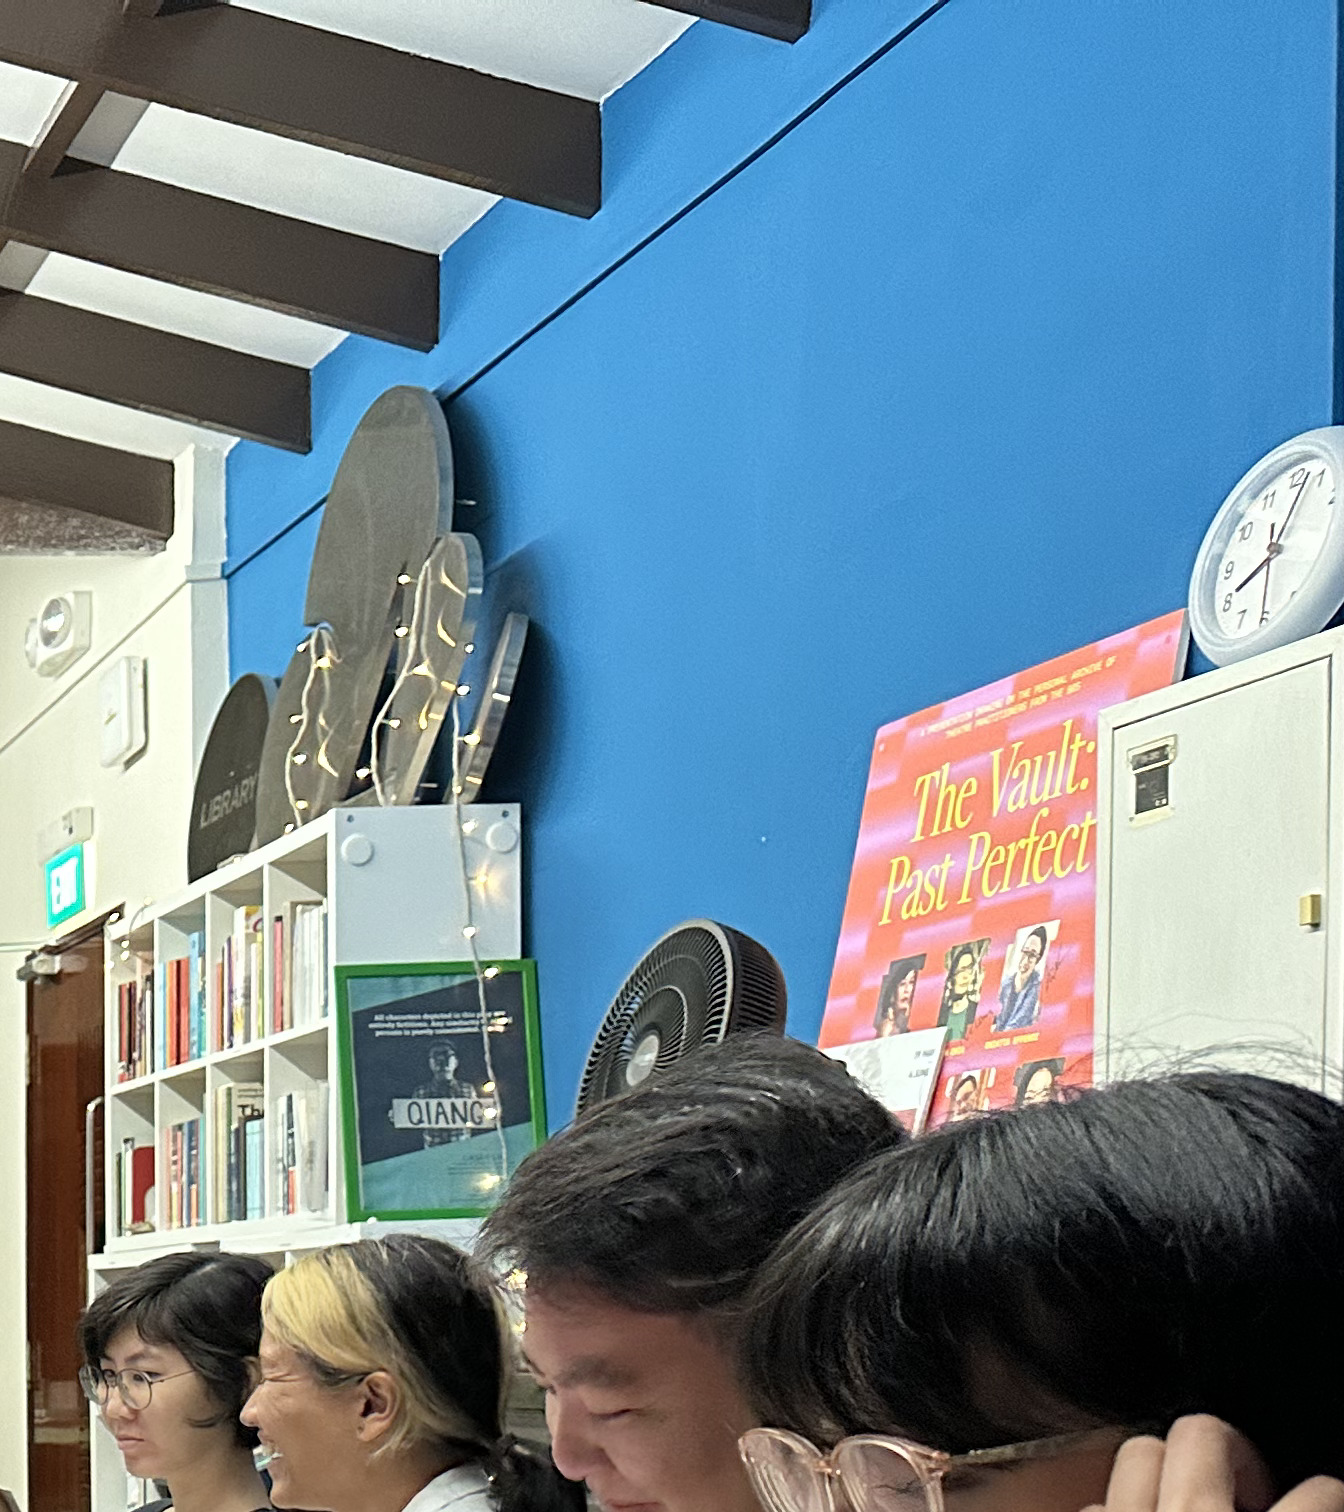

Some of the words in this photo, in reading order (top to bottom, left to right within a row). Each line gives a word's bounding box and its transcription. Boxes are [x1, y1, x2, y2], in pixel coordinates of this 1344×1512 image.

[1289, 467, 1307, 489] 12
[1262, 490, 1276, 511] 11
[1238, 521, 1254, 542] 10
[1224, 561, 1234, 580] 9
[1222, 592, 1233, 613] 8
[1237, 609, 1247, 629] 7
[911, 762, 978, 843] The
[990, 719, 1096, 818] Vault:
[199, 772, 258, 830] LIBRARY
[878, 853, 956, 926] Past
[957, 807, 1098, 905] Perfect
[407, 1100, 484, 1126] QIANG
